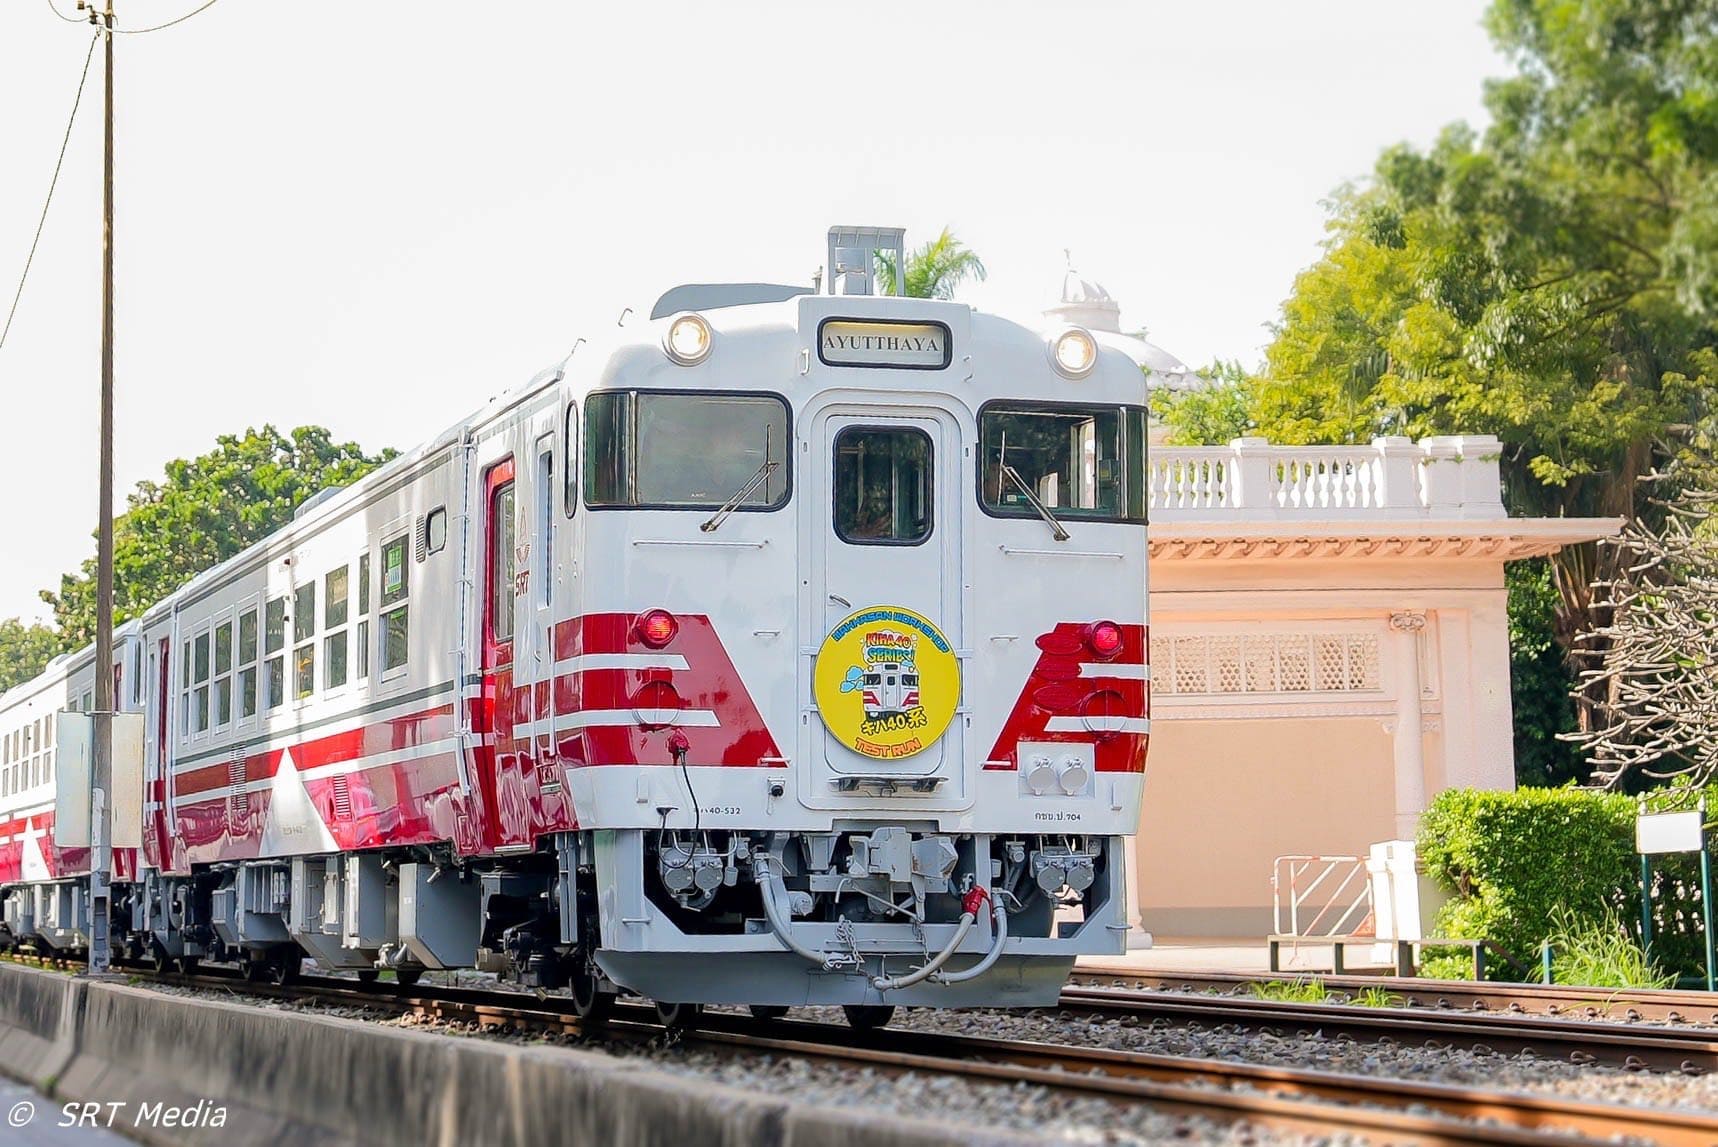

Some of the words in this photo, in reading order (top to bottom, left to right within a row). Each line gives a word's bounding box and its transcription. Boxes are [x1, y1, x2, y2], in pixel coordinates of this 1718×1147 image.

[823, 335, 939, 351] AYUTTHAYA
[515, 569, 530, 597] SRT
[866, 632, 894, 647] KIHA
[895, 635, 912, 649] 40
[893, 611, 950, 653] WORKSHOP
[861, 706, 928, 735] キハ40系
[855, 737, 891, 757] TEST
[891, 737, 922, 757] RUN
